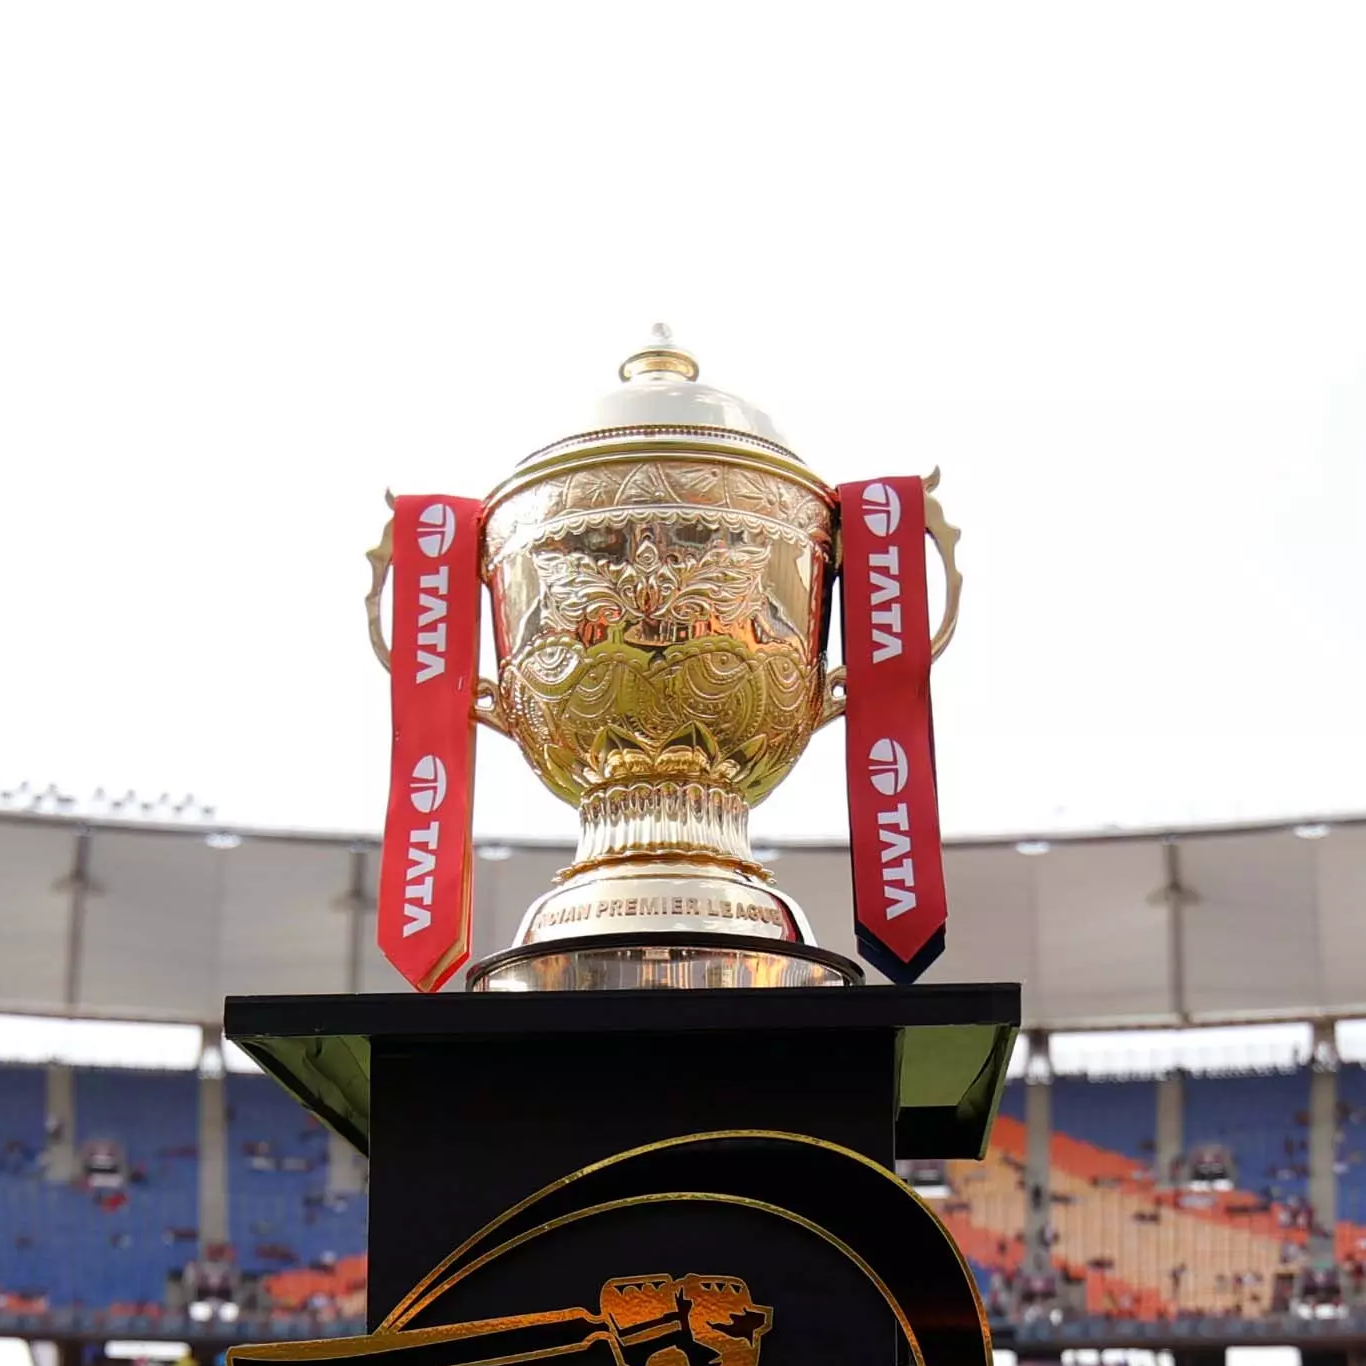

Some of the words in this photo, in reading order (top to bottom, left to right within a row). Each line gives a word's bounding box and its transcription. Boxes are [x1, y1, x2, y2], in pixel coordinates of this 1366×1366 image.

[415, 565, 449, 684] TATA
[868, 545, 903, 664] TATA
[402, 820, 440, 938] TATA
[596, 898, 699, 918] PREMIER
[708, 898, 783, 927] LEAGUE
[877, 802, 917, 921] TATA
